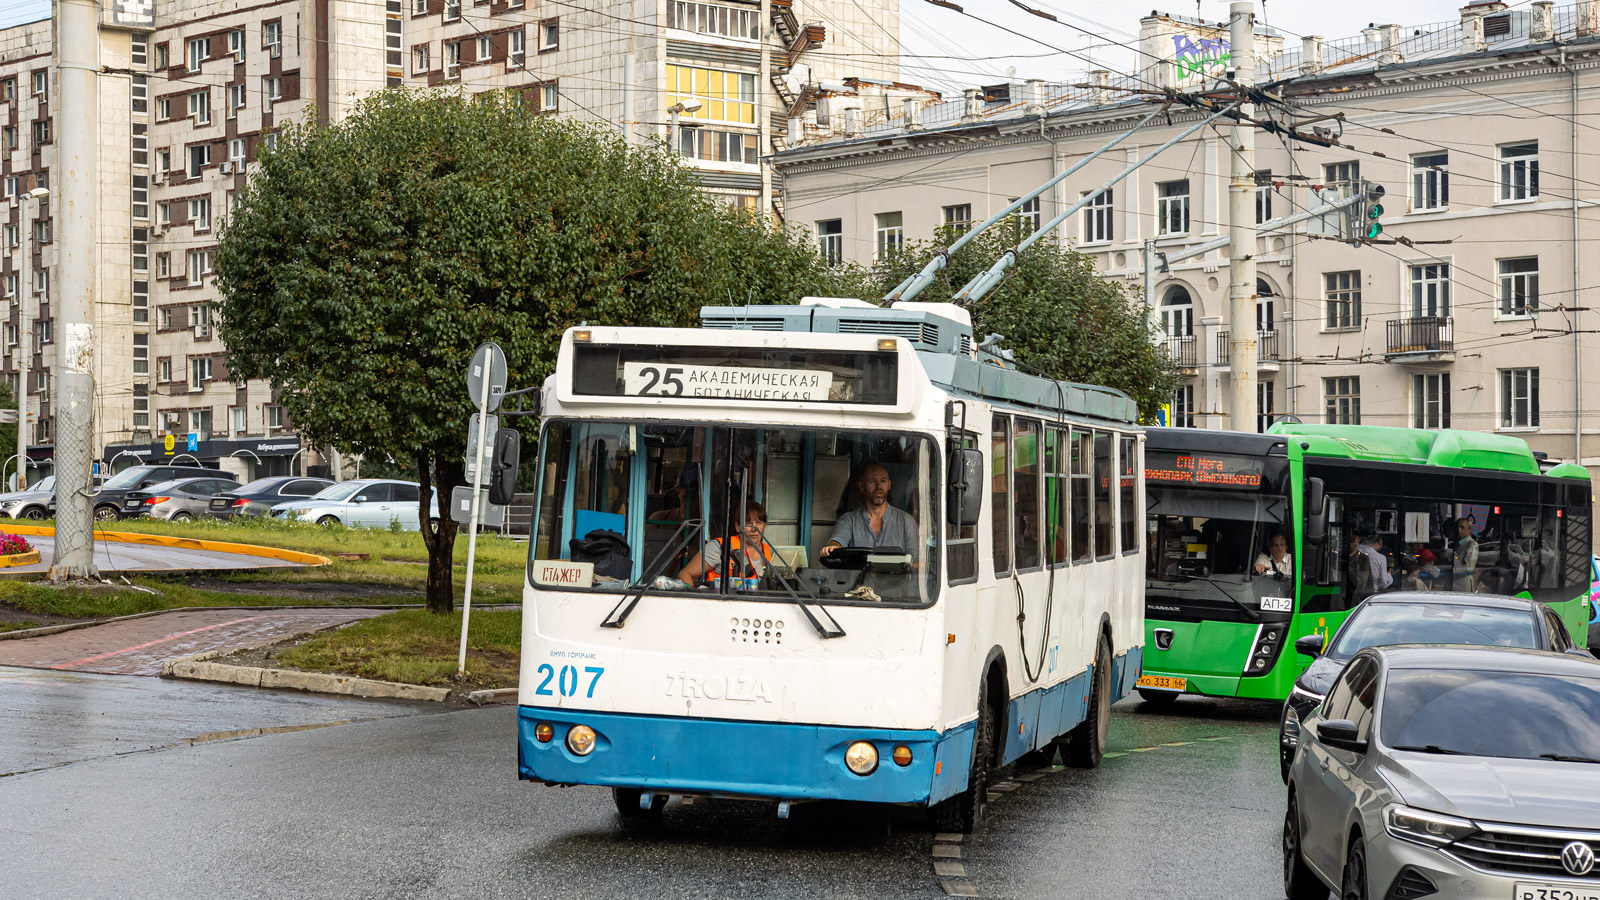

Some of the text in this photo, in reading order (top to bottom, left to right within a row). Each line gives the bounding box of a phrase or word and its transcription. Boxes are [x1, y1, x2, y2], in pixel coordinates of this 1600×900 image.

[638, 367, 684, 396] 25
[689, 370, 819, 388] АКАДЕМИЧЕСКАЯ
[694, 387, 811, 400] БОТАНИЧЕСКАЯ
[1176, 455, 1224, 471] СТЦ Мега
[1144, 468, 1261, 486] ехнопарк (Высоцкого)
[542, 567, 582, 583] СТАЖЕР
[1147, 604, 1181, 612] KAMAZ
[1262, 599, 1291, 610] АП-2
[1048, 645, 1059, 674] 207
[535, 663, 605, 699] 207
[1153, 677, 1170, 687] 333
